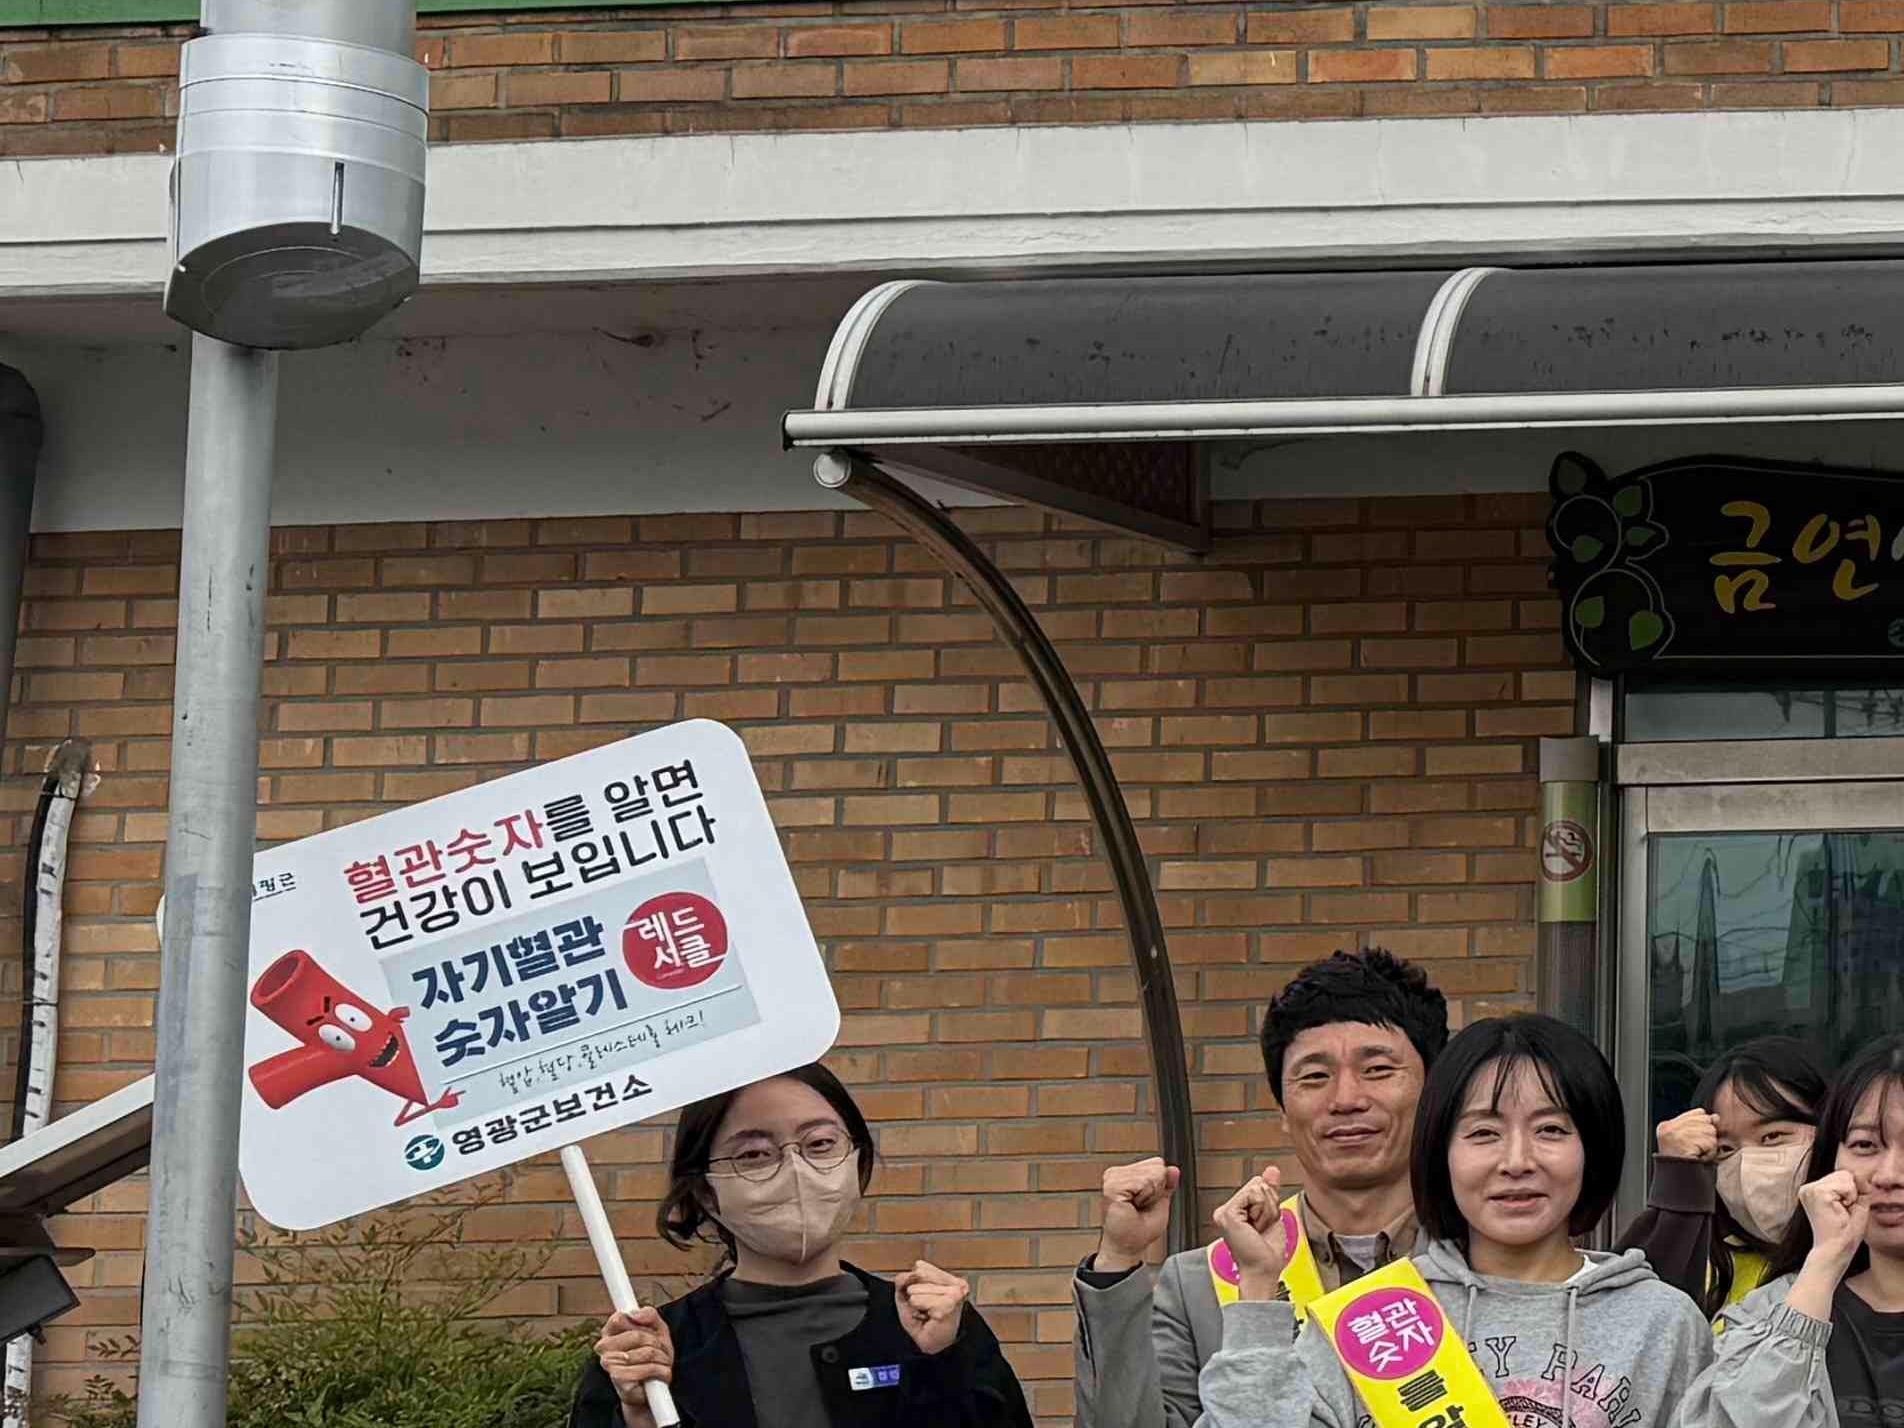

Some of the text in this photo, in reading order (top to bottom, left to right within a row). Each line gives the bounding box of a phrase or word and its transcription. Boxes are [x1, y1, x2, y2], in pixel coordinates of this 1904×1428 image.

[343, 759, 703, 903] 혈관숫자를 알면
[361, 805, 716, 951] 건강이 보입니다
[412, 915, 606, 1009] 자기혈관
[623, 906, 704, 942] 레드
[653, 934, 727, 970] 서클
[432, 968, 628, 1068] 숫자알기
[451, 1073, 653, 1156] 영광군보건소
